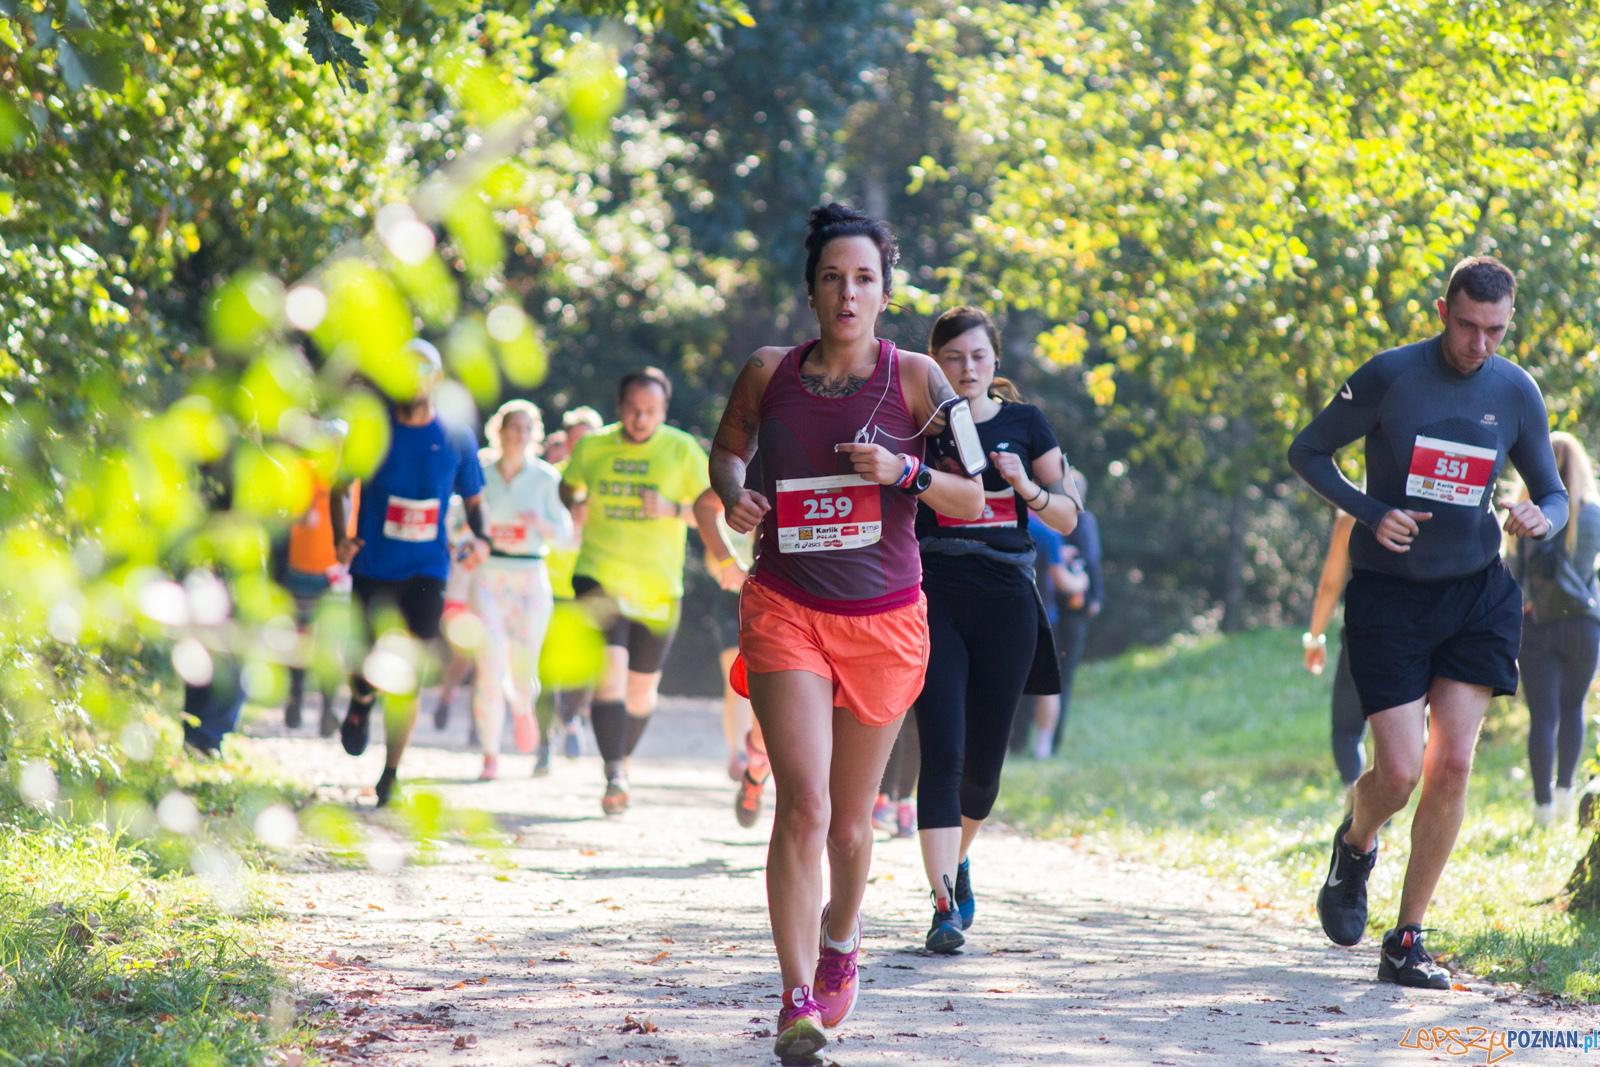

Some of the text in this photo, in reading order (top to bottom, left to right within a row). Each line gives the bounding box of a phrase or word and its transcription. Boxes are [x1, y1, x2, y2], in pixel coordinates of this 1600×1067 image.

[1434, 457, 1469, 480] 551
[803, 496, 853, 520] 259
[816, 526, 838, 534] Karlik
